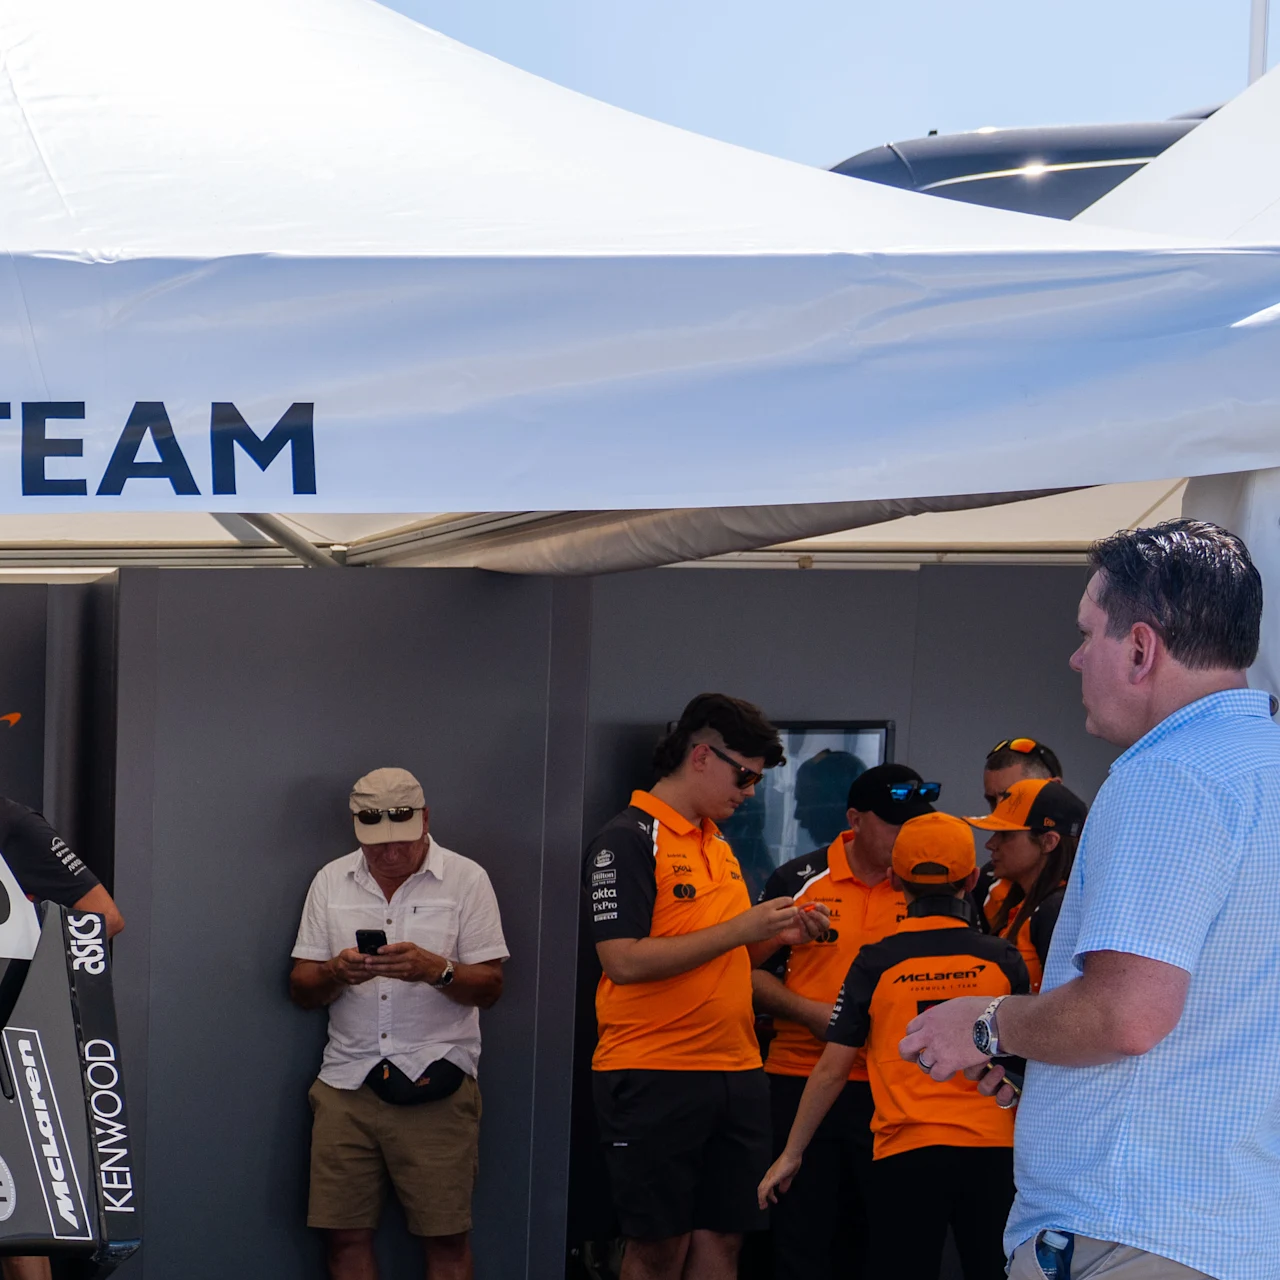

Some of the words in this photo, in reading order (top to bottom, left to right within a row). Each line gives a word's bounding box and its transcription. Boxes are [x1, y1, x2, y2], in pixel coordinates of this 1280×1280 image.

[593, 872, 614, 881] Hilton
[592, 887, 617, 900] okta
[593, 901, 618, 912] FxPro
[67, 913, 105, 975] asics
[893, 970, 977, 984] McLaren
[84, 1038, 135, 1213] KENWOOD
[18, 1038, 79, 1230] McLaren
